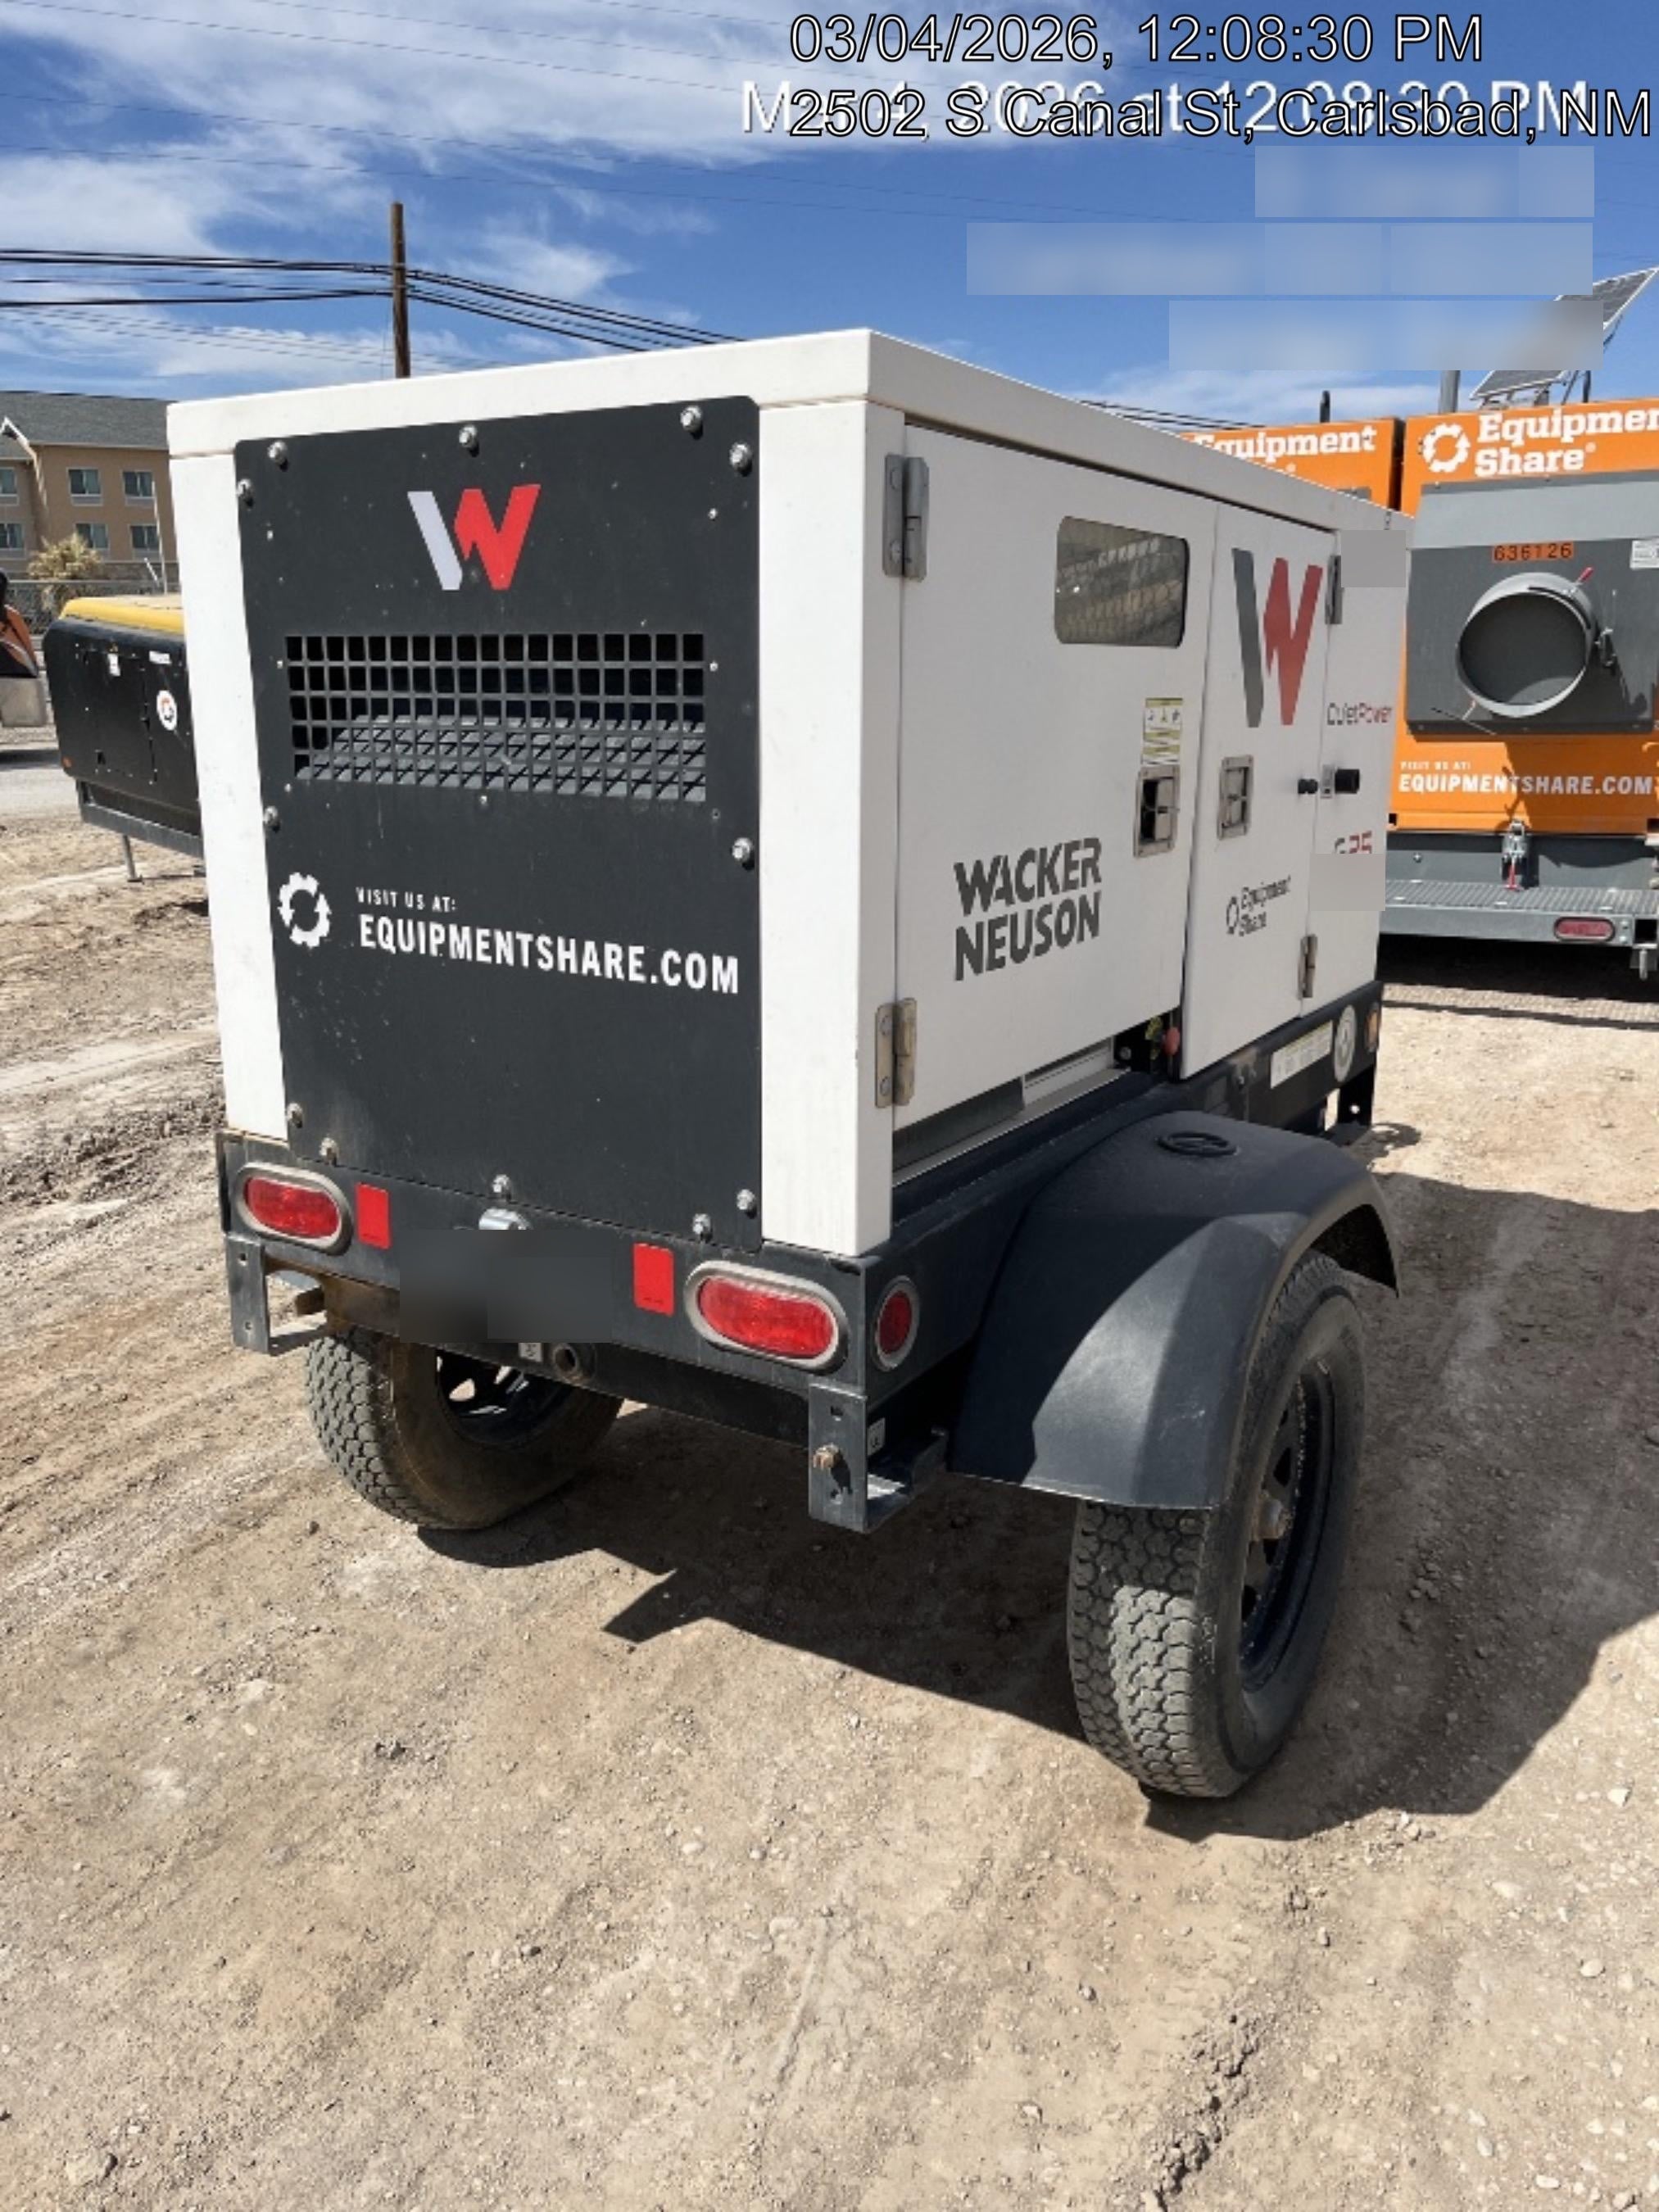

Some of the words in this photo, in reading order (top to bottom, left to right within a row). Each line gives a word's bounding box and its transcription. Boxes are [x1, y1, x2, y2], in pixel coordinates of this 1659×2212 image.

[1494, 542, 1572, 561] 636126
[1398, 773, 1653, 795] EQUIPMENTSHARE.COM
[356, 886, 398, 909] VISIT
[404, 891, 425, 911] US
[431, 894, 456, 913] AT:
[954, 837, 1102, 917] WACKER
[359, 913, 738, 994] EQUIPMENTSHARE.COM
[954, 891, 1102, 981] NEUSON
